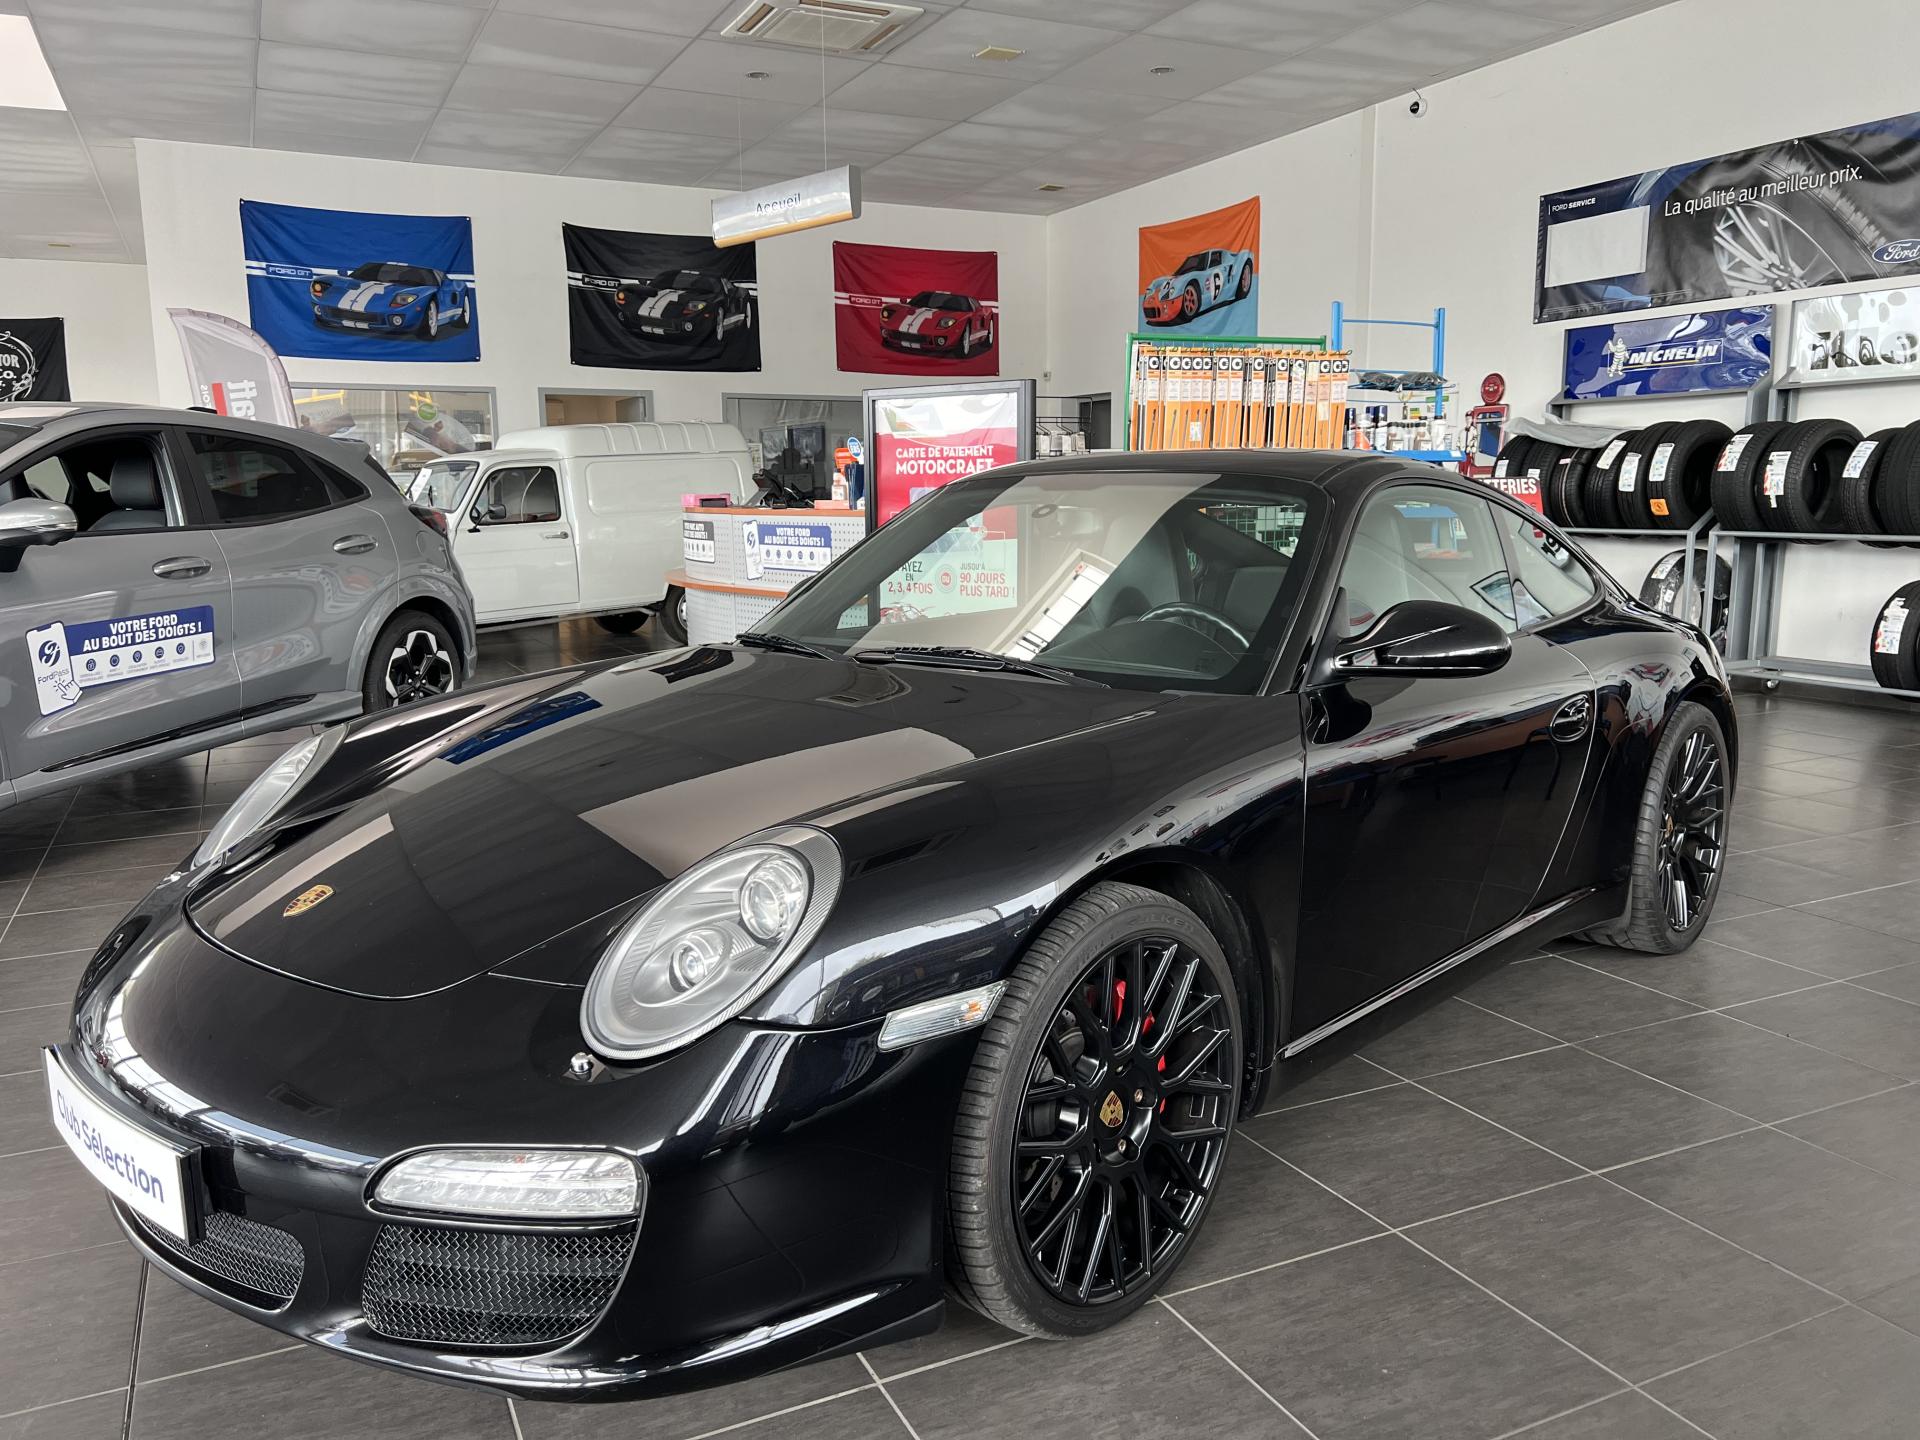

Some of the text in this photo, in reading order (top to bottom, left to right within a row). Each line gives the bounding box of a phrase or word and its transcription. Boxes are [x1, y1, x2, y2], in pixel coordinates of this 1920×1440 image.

[1664, 164, 1864, 217] La qualité au meilleur prix.
[756, 192, 801, 213] Accueil
[1552, 197, 1597, 212] FORD SERVICE
[1883, 242, 1920, 261] Ford
[269, 266, 297, 275] FORD
[584, 277, 607, 286] FORD
[850, 296, 872, 304] FORD
[1628, 344, 1719, 365] MICHELIN
[895, 446, 994, 458] CARTE DE PAIEMENT
[895, 458, 994, 475] MOTORCRAFT
[775, 527, 811, 537] VOTRE FORD
[764, 535, 773, 544] AU
[773, 535, 787, 545] BOUT
[788, 536, 799, 546] DES
[800, 537, 820, 546] DOIGTS
[960, 572, 1006, 584] 90 JOURS
[913, 582, 933, 594] FOIS
[960, 584, 982, 597] PLUS
[985, 586, 1009, 598] TARD
[109, 614, 178, 635] VOTRE FORD
[83, 638, 100, 653] AU
[101, 632, 134, 648] BOUT
[135, 628, 157, 643] DES
[158, 622, 196, 638] DOIGTS
[37, 669, 70, 684] FordPass
[56, 1088, 165, 1204] Club Sélection
